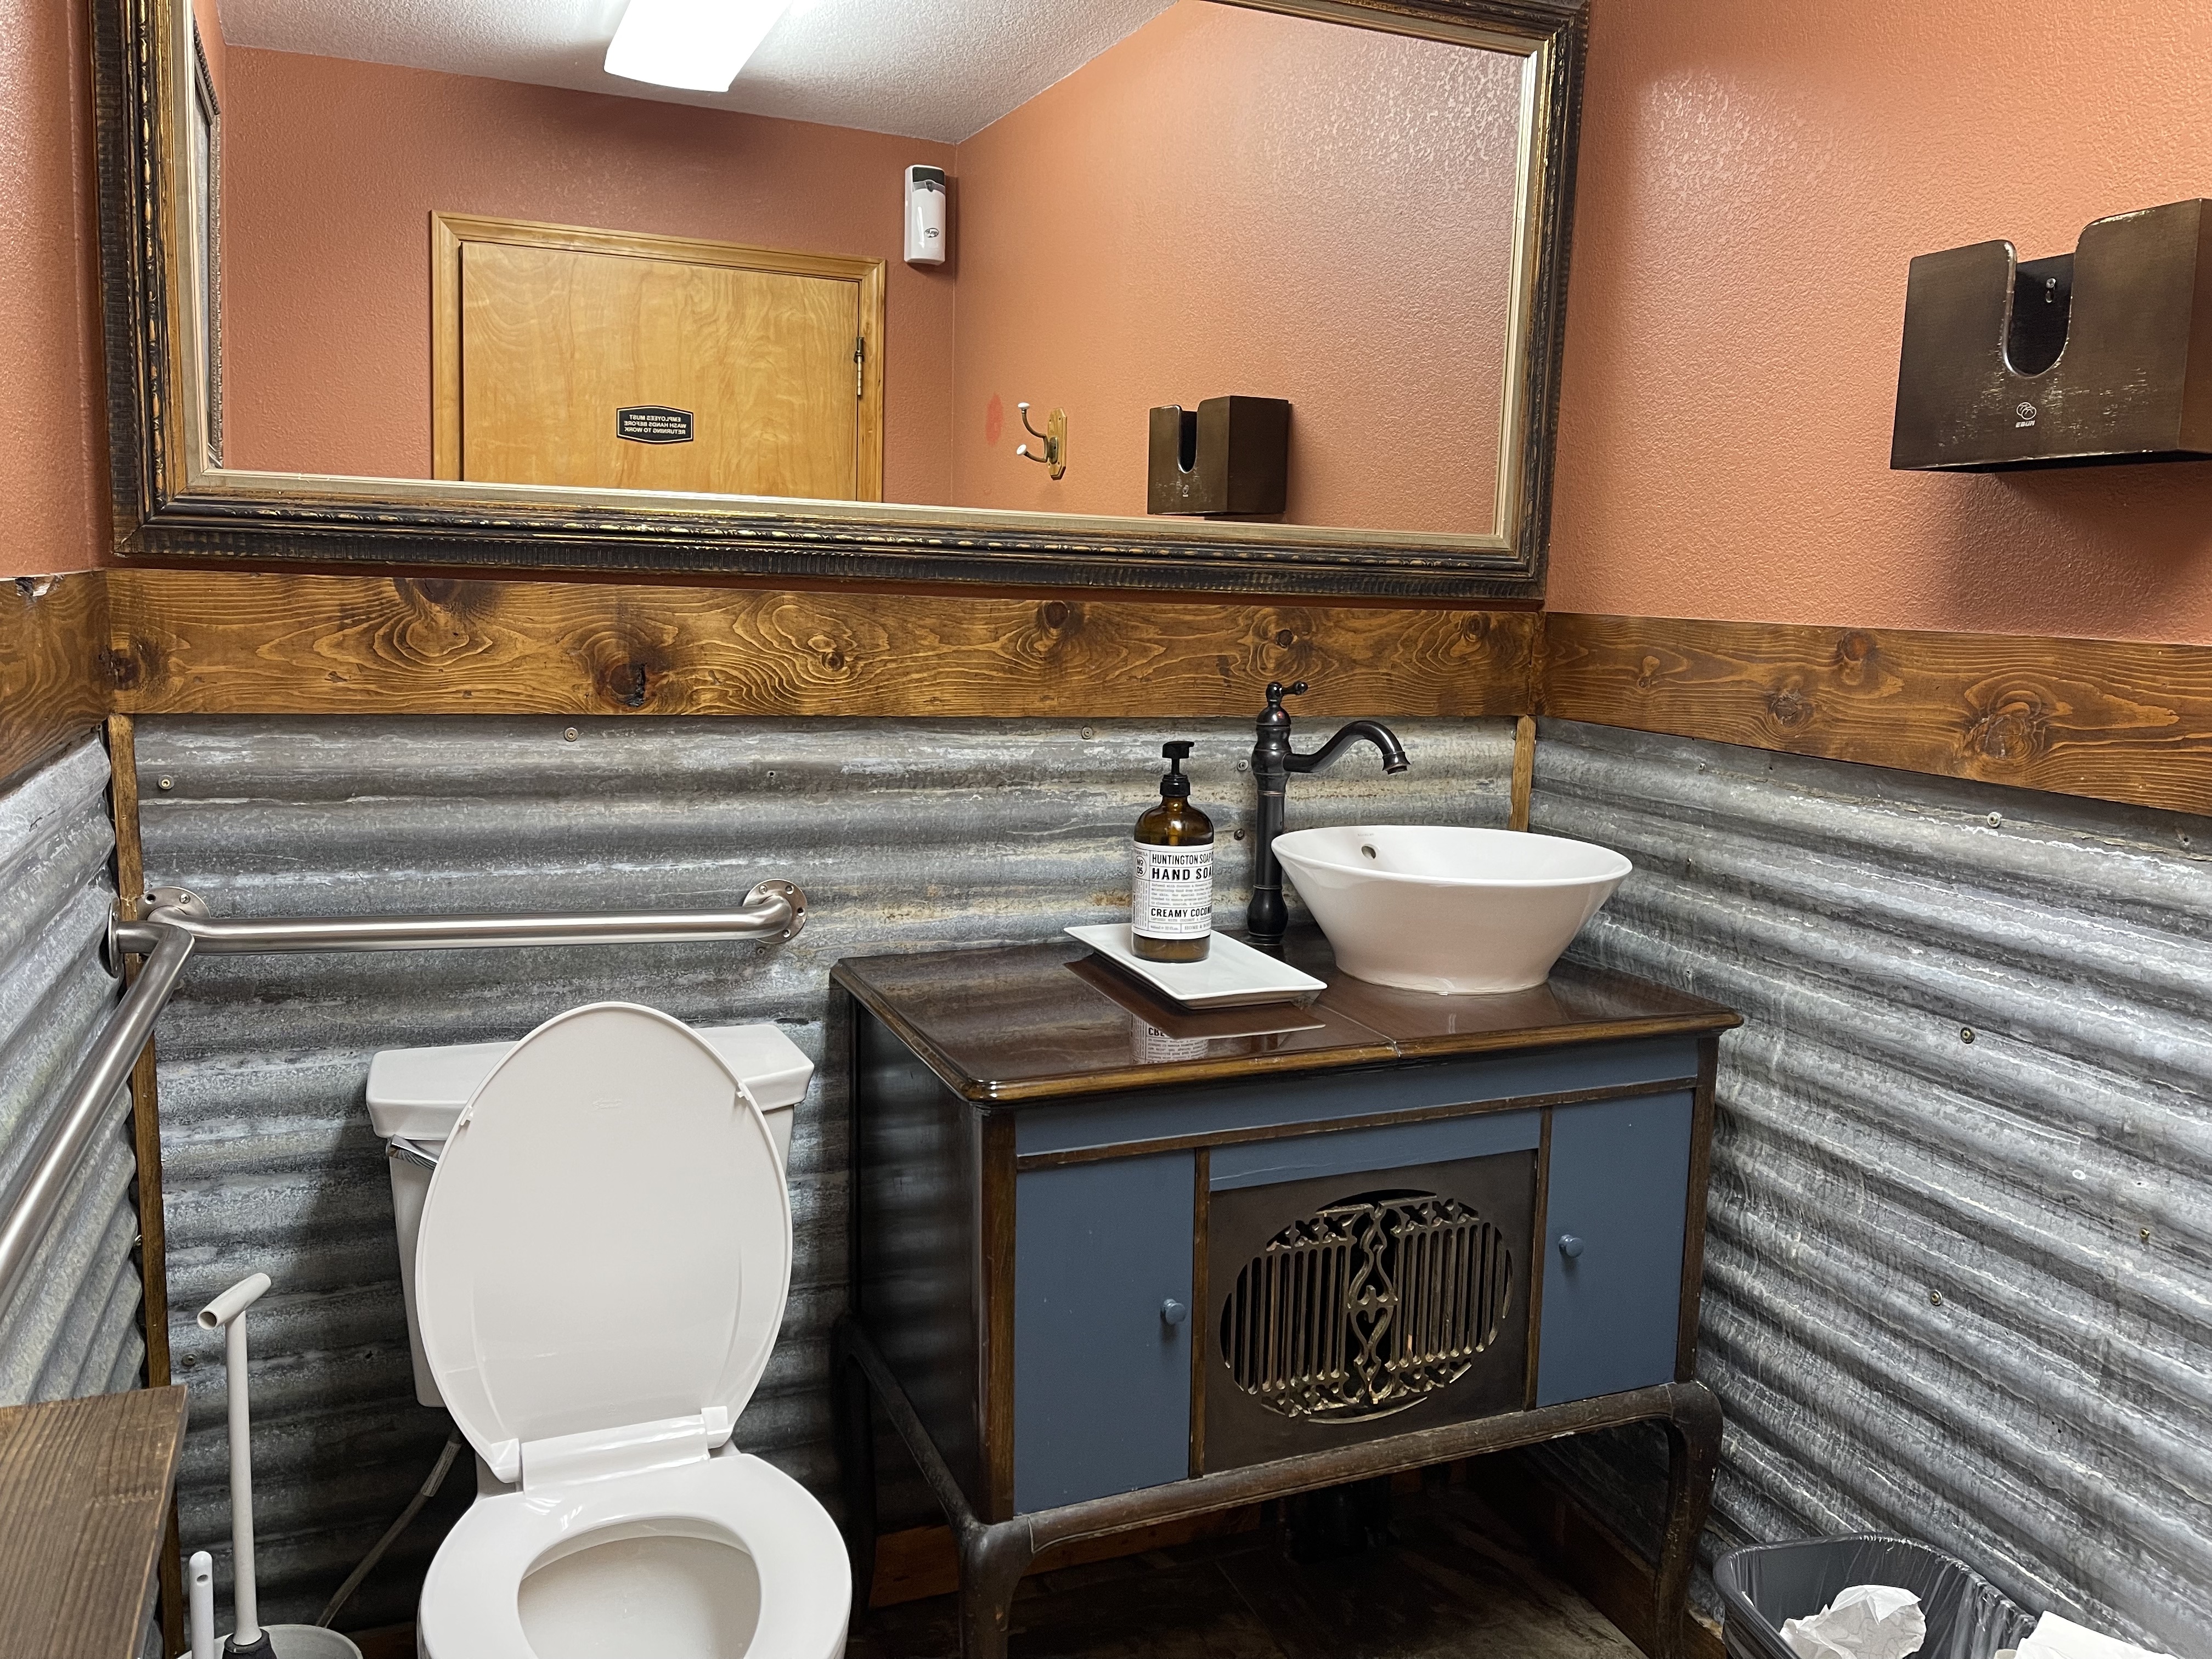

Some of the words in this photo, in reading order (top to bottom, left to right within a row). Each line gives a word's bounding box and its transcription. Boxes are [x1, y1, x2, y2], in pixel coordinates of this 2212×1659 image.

[1152, 853, 1198, 865] HUNTINGTON
[1152, 867, 1190, 881] HAND
[1196, 865, 1214, 880] SOA
[1151, 908, 1188, 918] CREAMY
